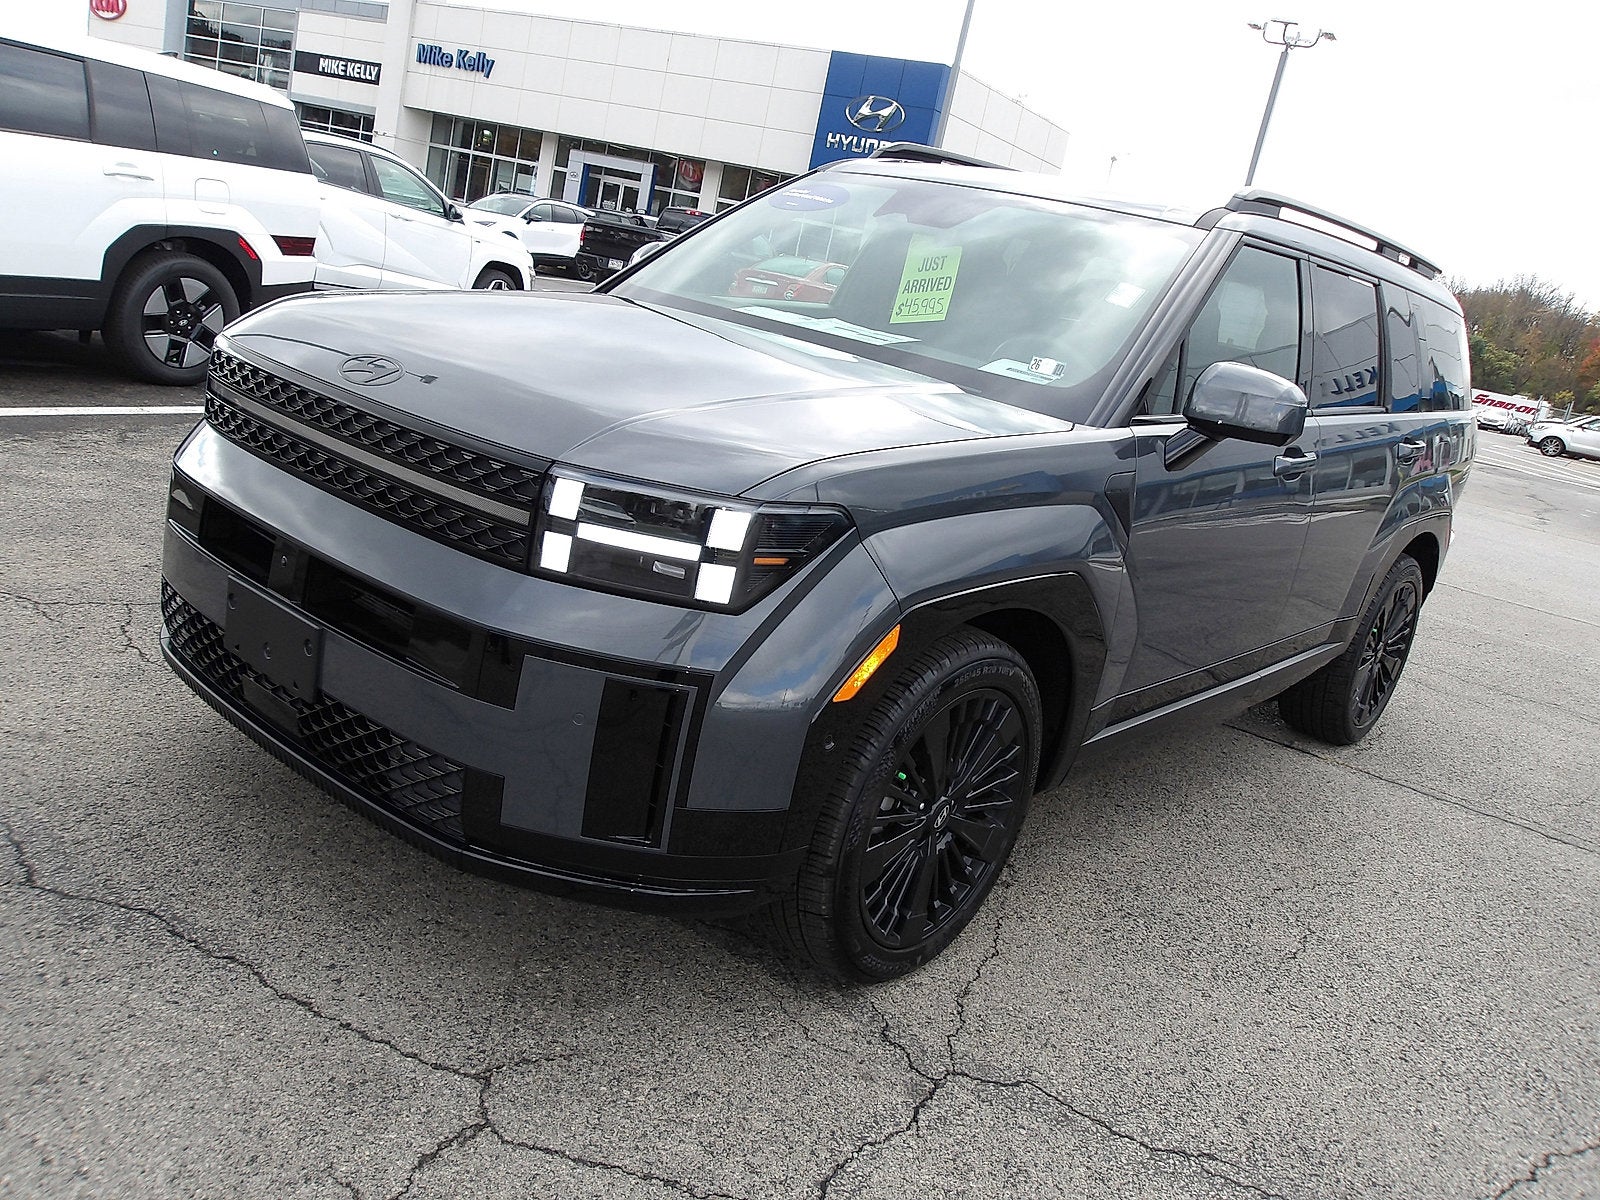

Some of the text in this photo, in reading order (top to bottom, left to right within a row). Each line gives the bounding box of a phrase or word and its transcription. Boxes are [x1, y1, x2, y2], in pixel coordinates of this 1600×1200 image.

[319, 57, 379, 81] MIKE KELLY
[416, 43, 495, 79] Mike Kelly
[918, 256, 947, 272] JUST
[902, 276, 952, 294] ARRIVED
[1030, 358, 1043, 371] 26
[1472, 394, 1540, 415] Snap-on
